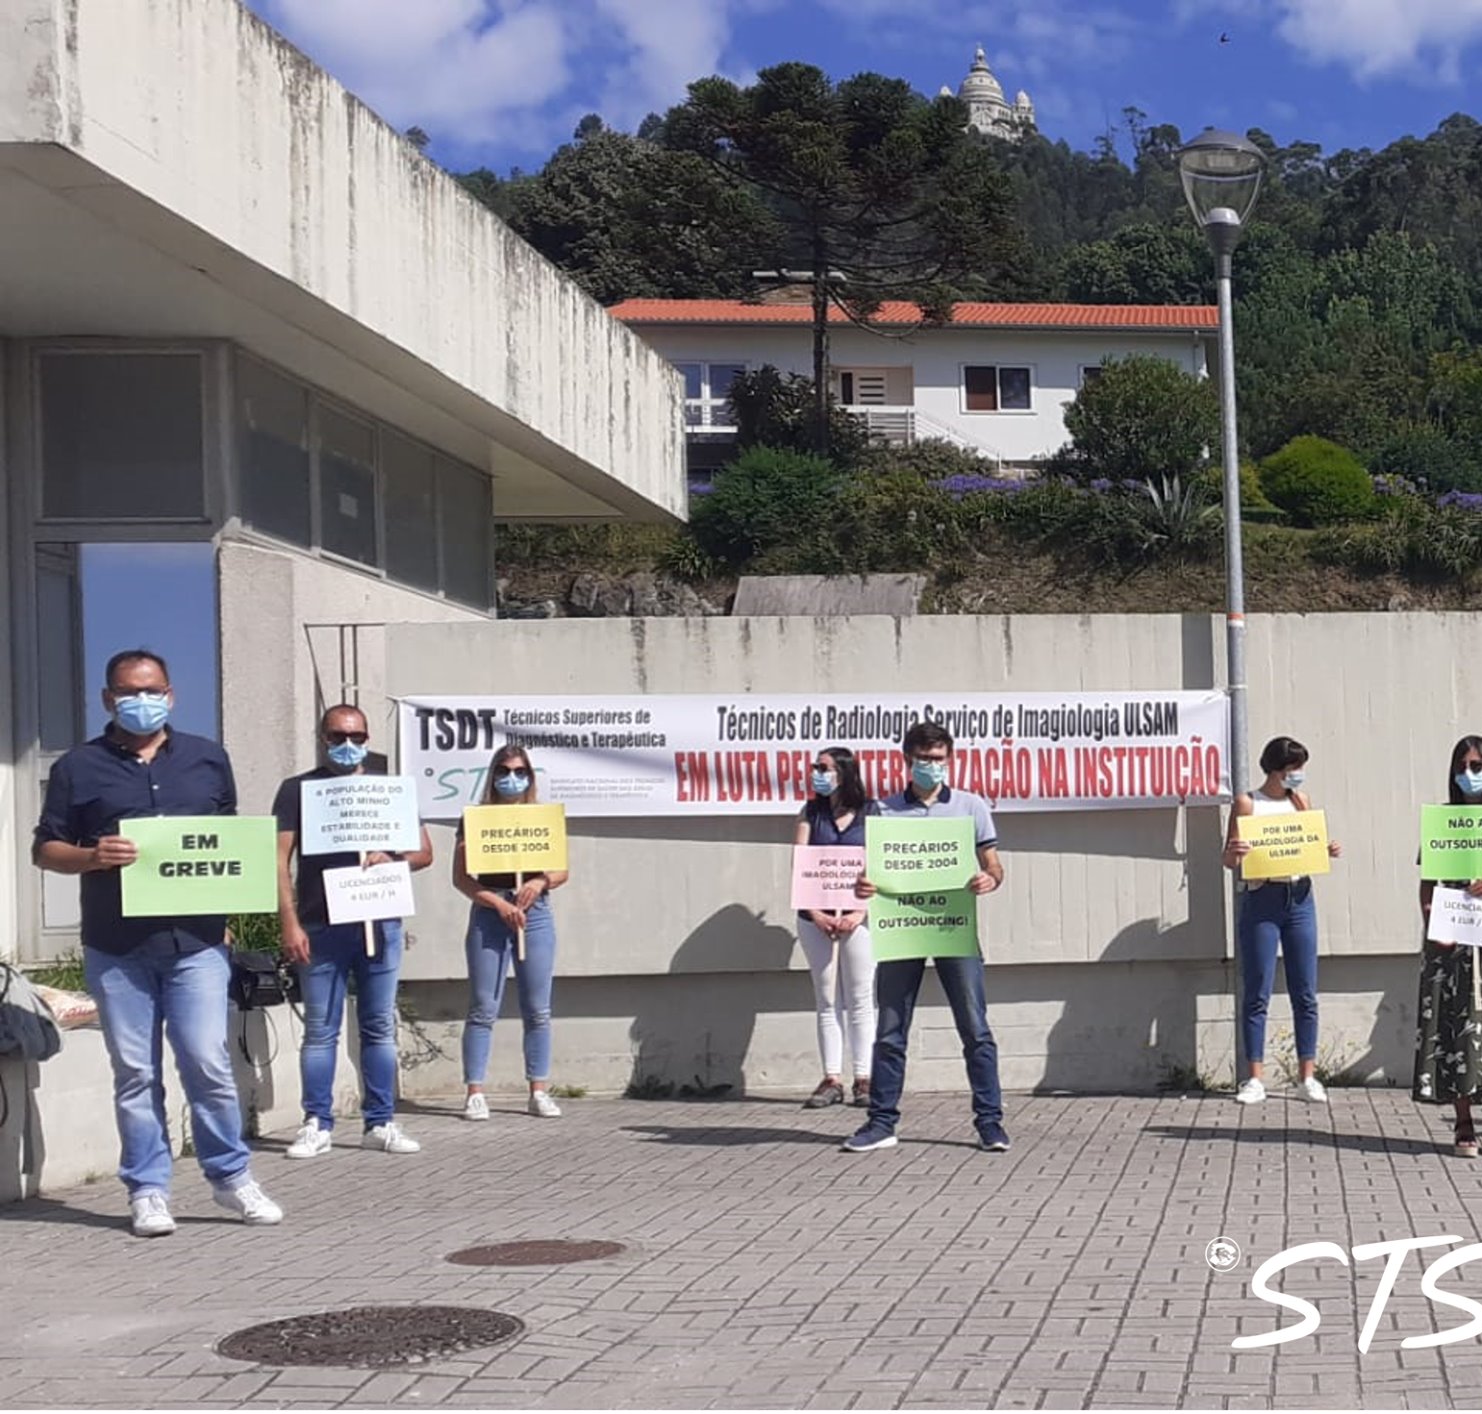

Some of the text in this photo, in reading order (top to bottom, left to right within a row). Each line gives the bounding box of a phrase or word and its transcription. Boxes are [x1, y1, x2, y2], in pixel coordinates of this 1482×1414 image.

[504, 708, 652, 727] Técnicos Superiores de
[717, 705, 796, 741] Técnicos
[801, 706, 822, 740] de
[826, 705, 919, 743] Radiologia
[993, 704, 1014, 739] de
[1018, 703, 1120, 742] Imagiologia
[1124, 702, 1178, 736] ULSAM
[415, 707, 496, 751] TSDT
[506, 731, 667, 749] Diagnóstico e Terapêutica
[674, 751, 710, 802] EM
[714, 751, 772, 802] LUTA
[776, 750, 816, 801] PEL
[1037, 747, 1069, 798] NA
[1074, 736, 1220, 804] INSTITUIÇÃO
[1448, 815, 1474, 828] NÃO
[481, 826, 550, 839] PRECÁRIOS
[1263, 825, 1303, 835] POR UMA
[182, 834, 219, 850] EM
[1307, 835, 1320, 843] DA
[482, 842, 550, 853] DESDE 2004
[883, 840, 959, 854] PRECÁRIOS
[159, 861, 242, 877] GREVE
[819, 859, 863, 867] POR UMA
[884, 857, 958, 870] DESDE 2004
[929, 895, 947, 906] AO
[878, 915, 969, 929] OUTSOURCING!
